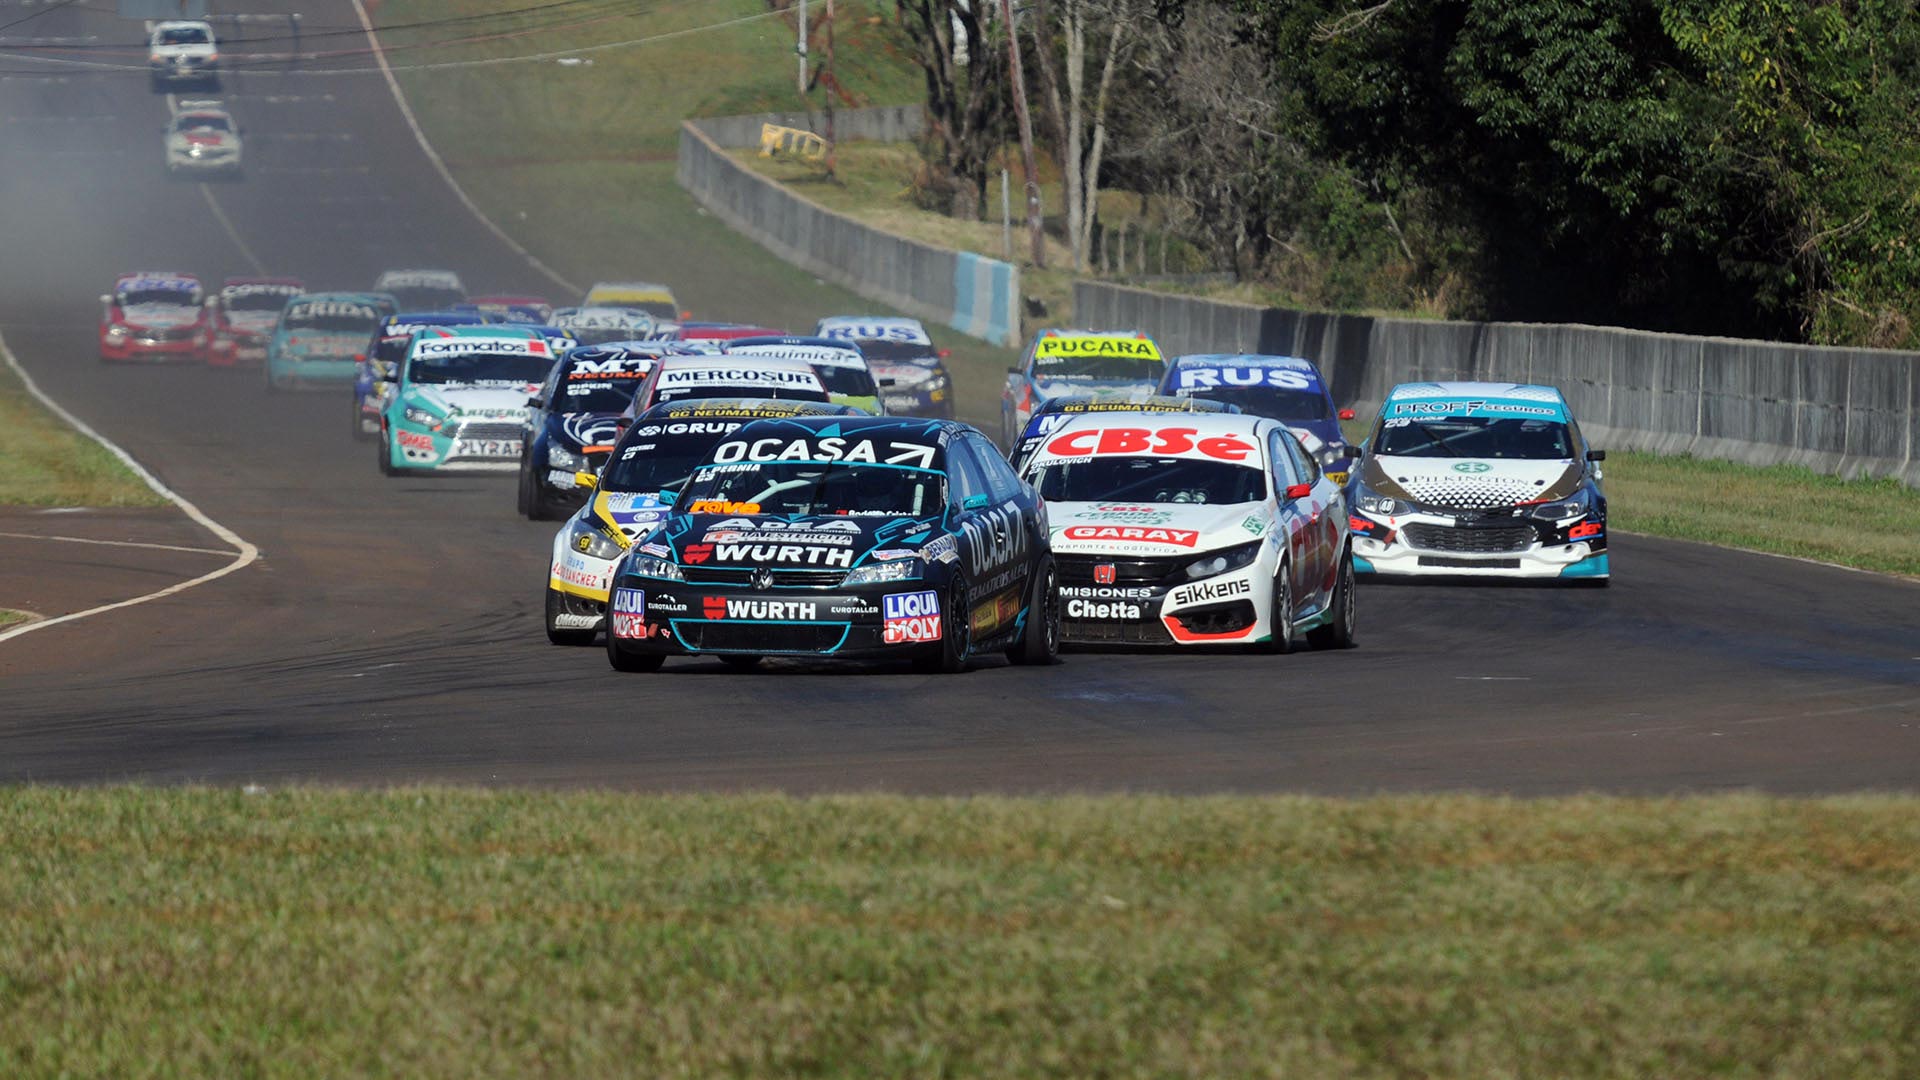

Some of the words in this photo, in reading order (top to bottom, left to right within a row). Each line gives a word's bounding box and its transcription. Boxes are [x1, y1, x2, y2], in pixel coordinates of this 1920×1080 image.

[828, 325, 918, 340] RUS
[421, 342, 526, 354] Formatos
[1042, 340, 1152, 356] PUCARA
[667, 369, 812, 385] MERCOSUR
[1180, 368, 1310, 389] RUS
[1485, 405, 1555, 416] SEGUROS
[713, 438, 877, 464] OCASA
[1046, 427, 1257, 460] CBSé
[1413, 475, 1529, 486] PILKINGTON
[1073, 528, 1191, 542] GARAY
[1059, 587, 1151, 598] MISIONES
[1175, 578, 1251, 605] sikkens
[648, 603, 688, 611] EUROTALLER
[727, 600, 816, 619] WÜRTH
[887, 594, 938, 617] LIQUI
[1067, 600, 1141, 619] Chetta
[888, 617, 940, 640] MOLY
